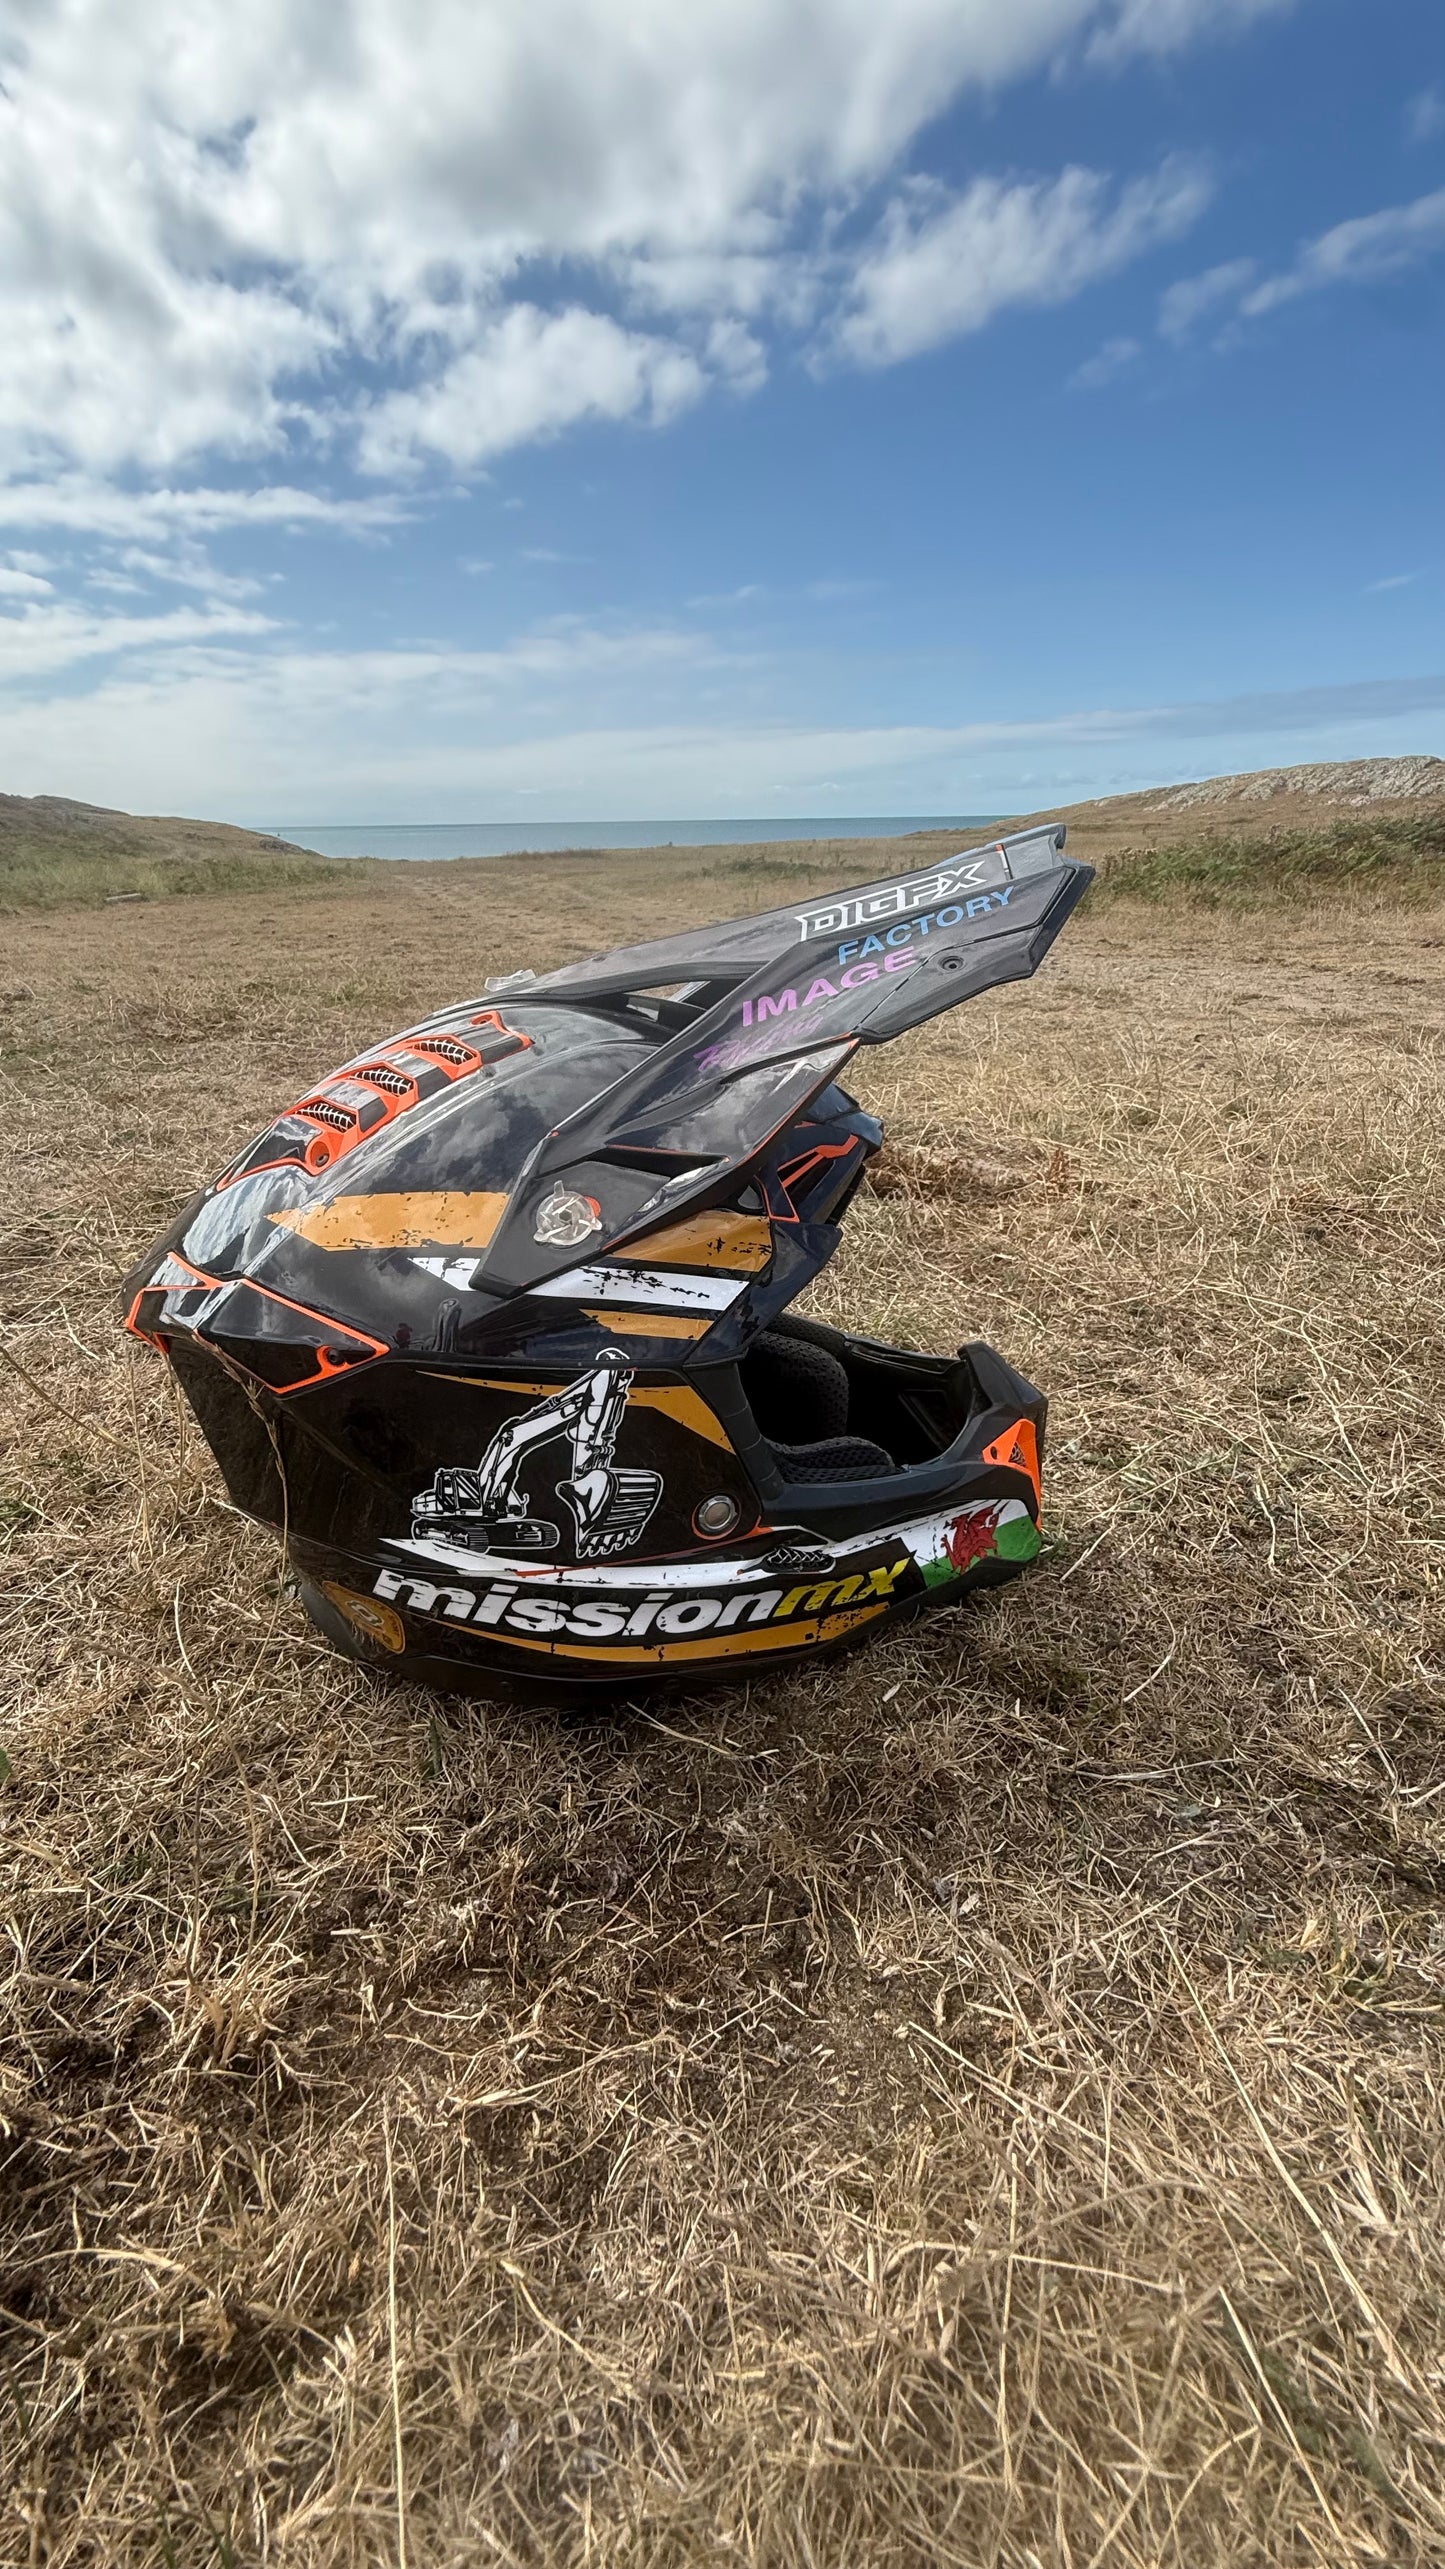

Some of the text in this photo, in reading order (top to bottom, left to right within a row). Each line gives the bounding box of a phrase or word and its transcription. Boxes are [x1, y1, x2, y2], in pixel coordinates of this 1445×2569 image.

[794, 861, 987, 942] DIGFX
[838, 886, 1014, 965] FACTORY
[742, 946, 916, 1027] IMAGE
